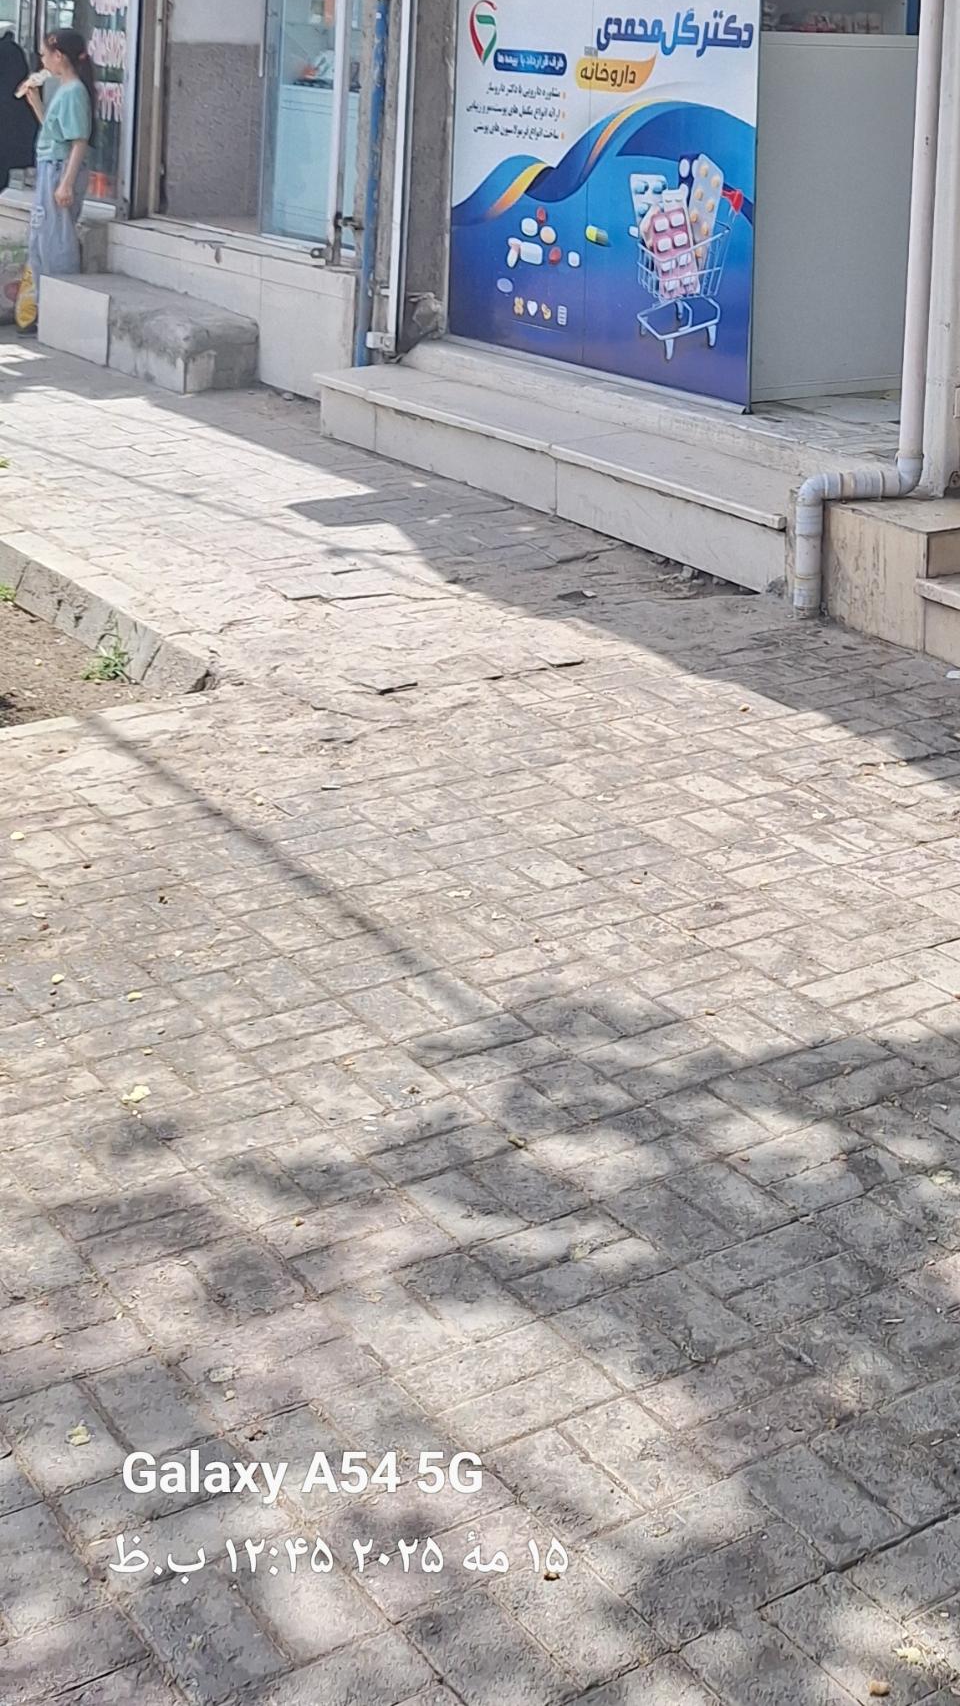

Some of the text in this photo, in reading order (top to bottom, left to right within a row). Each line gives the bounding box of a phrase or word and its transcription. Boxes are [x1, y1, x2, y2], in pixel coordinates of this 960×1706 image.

[596, 8, 754, 58] دکتر گل محمدی
[580, 62, 636, 87] داروخانه
